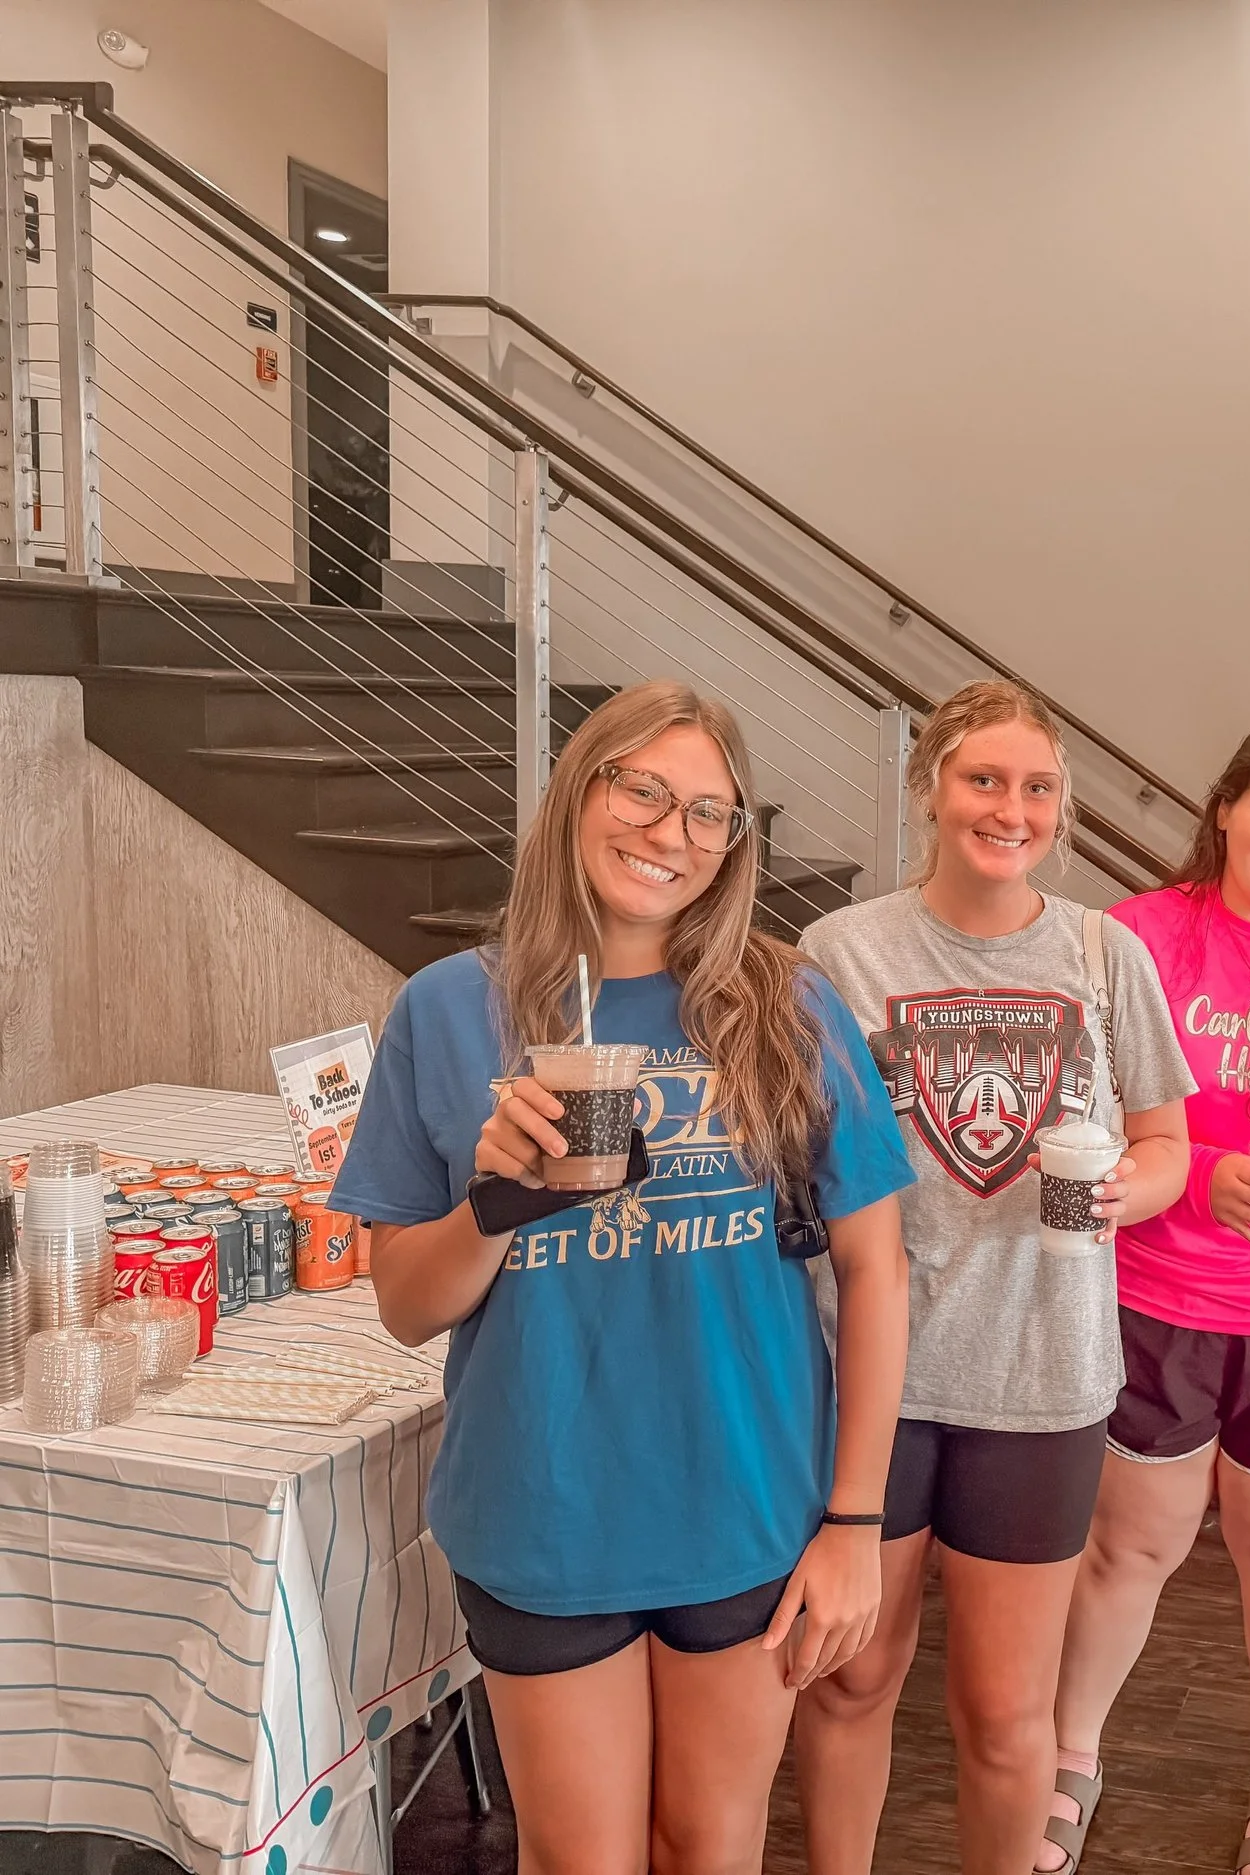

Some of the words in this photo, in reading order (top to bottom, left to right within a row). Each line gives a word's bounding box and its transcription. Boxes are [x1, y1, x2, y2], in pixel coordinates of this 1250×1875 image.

[927, 1008, 1045, 1024] YOUNGSTOWN
[639, 1046, 699, 1067] AME
[317, 1067, 346, 1091] Back
[309, 1093, 324, 1111] To
[325, 1079, 361, 1106] School
[322, 1107, 336, 1117] Dirty
[308, 1132, 338, 1150] September
[651, 1153, 729, 1180] LATIN
[503, 1229, 578, 1271] EET
[587, 1223, 644, 1261] OF
[654, 1206, 765, 1256] MILES
